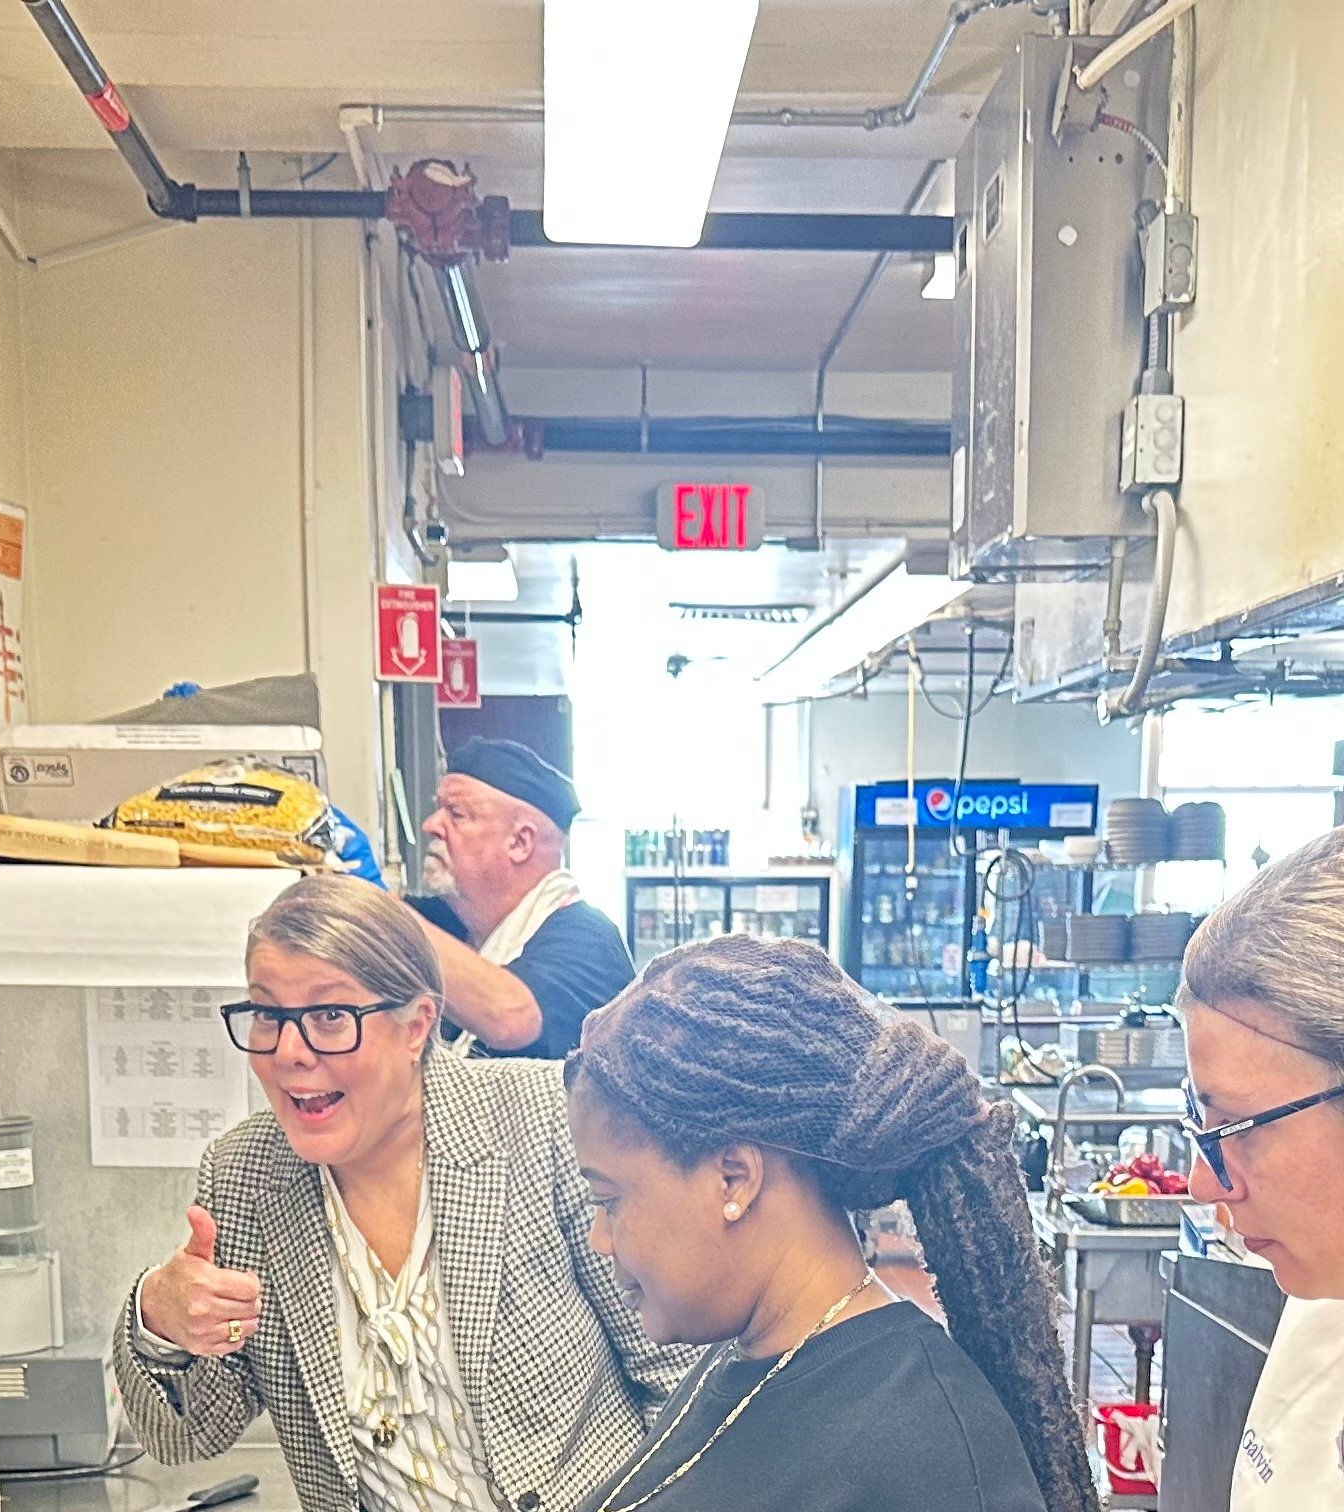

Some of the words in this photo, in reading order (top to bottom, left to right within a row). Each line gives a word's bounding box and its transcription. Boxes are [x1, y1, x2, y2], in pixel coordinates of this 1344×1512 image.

[674, 484, 751, 549] EXIT
[956, 791, 1029, 821] pepsi
[1240, 1428, 1276, 1486] Galvin
